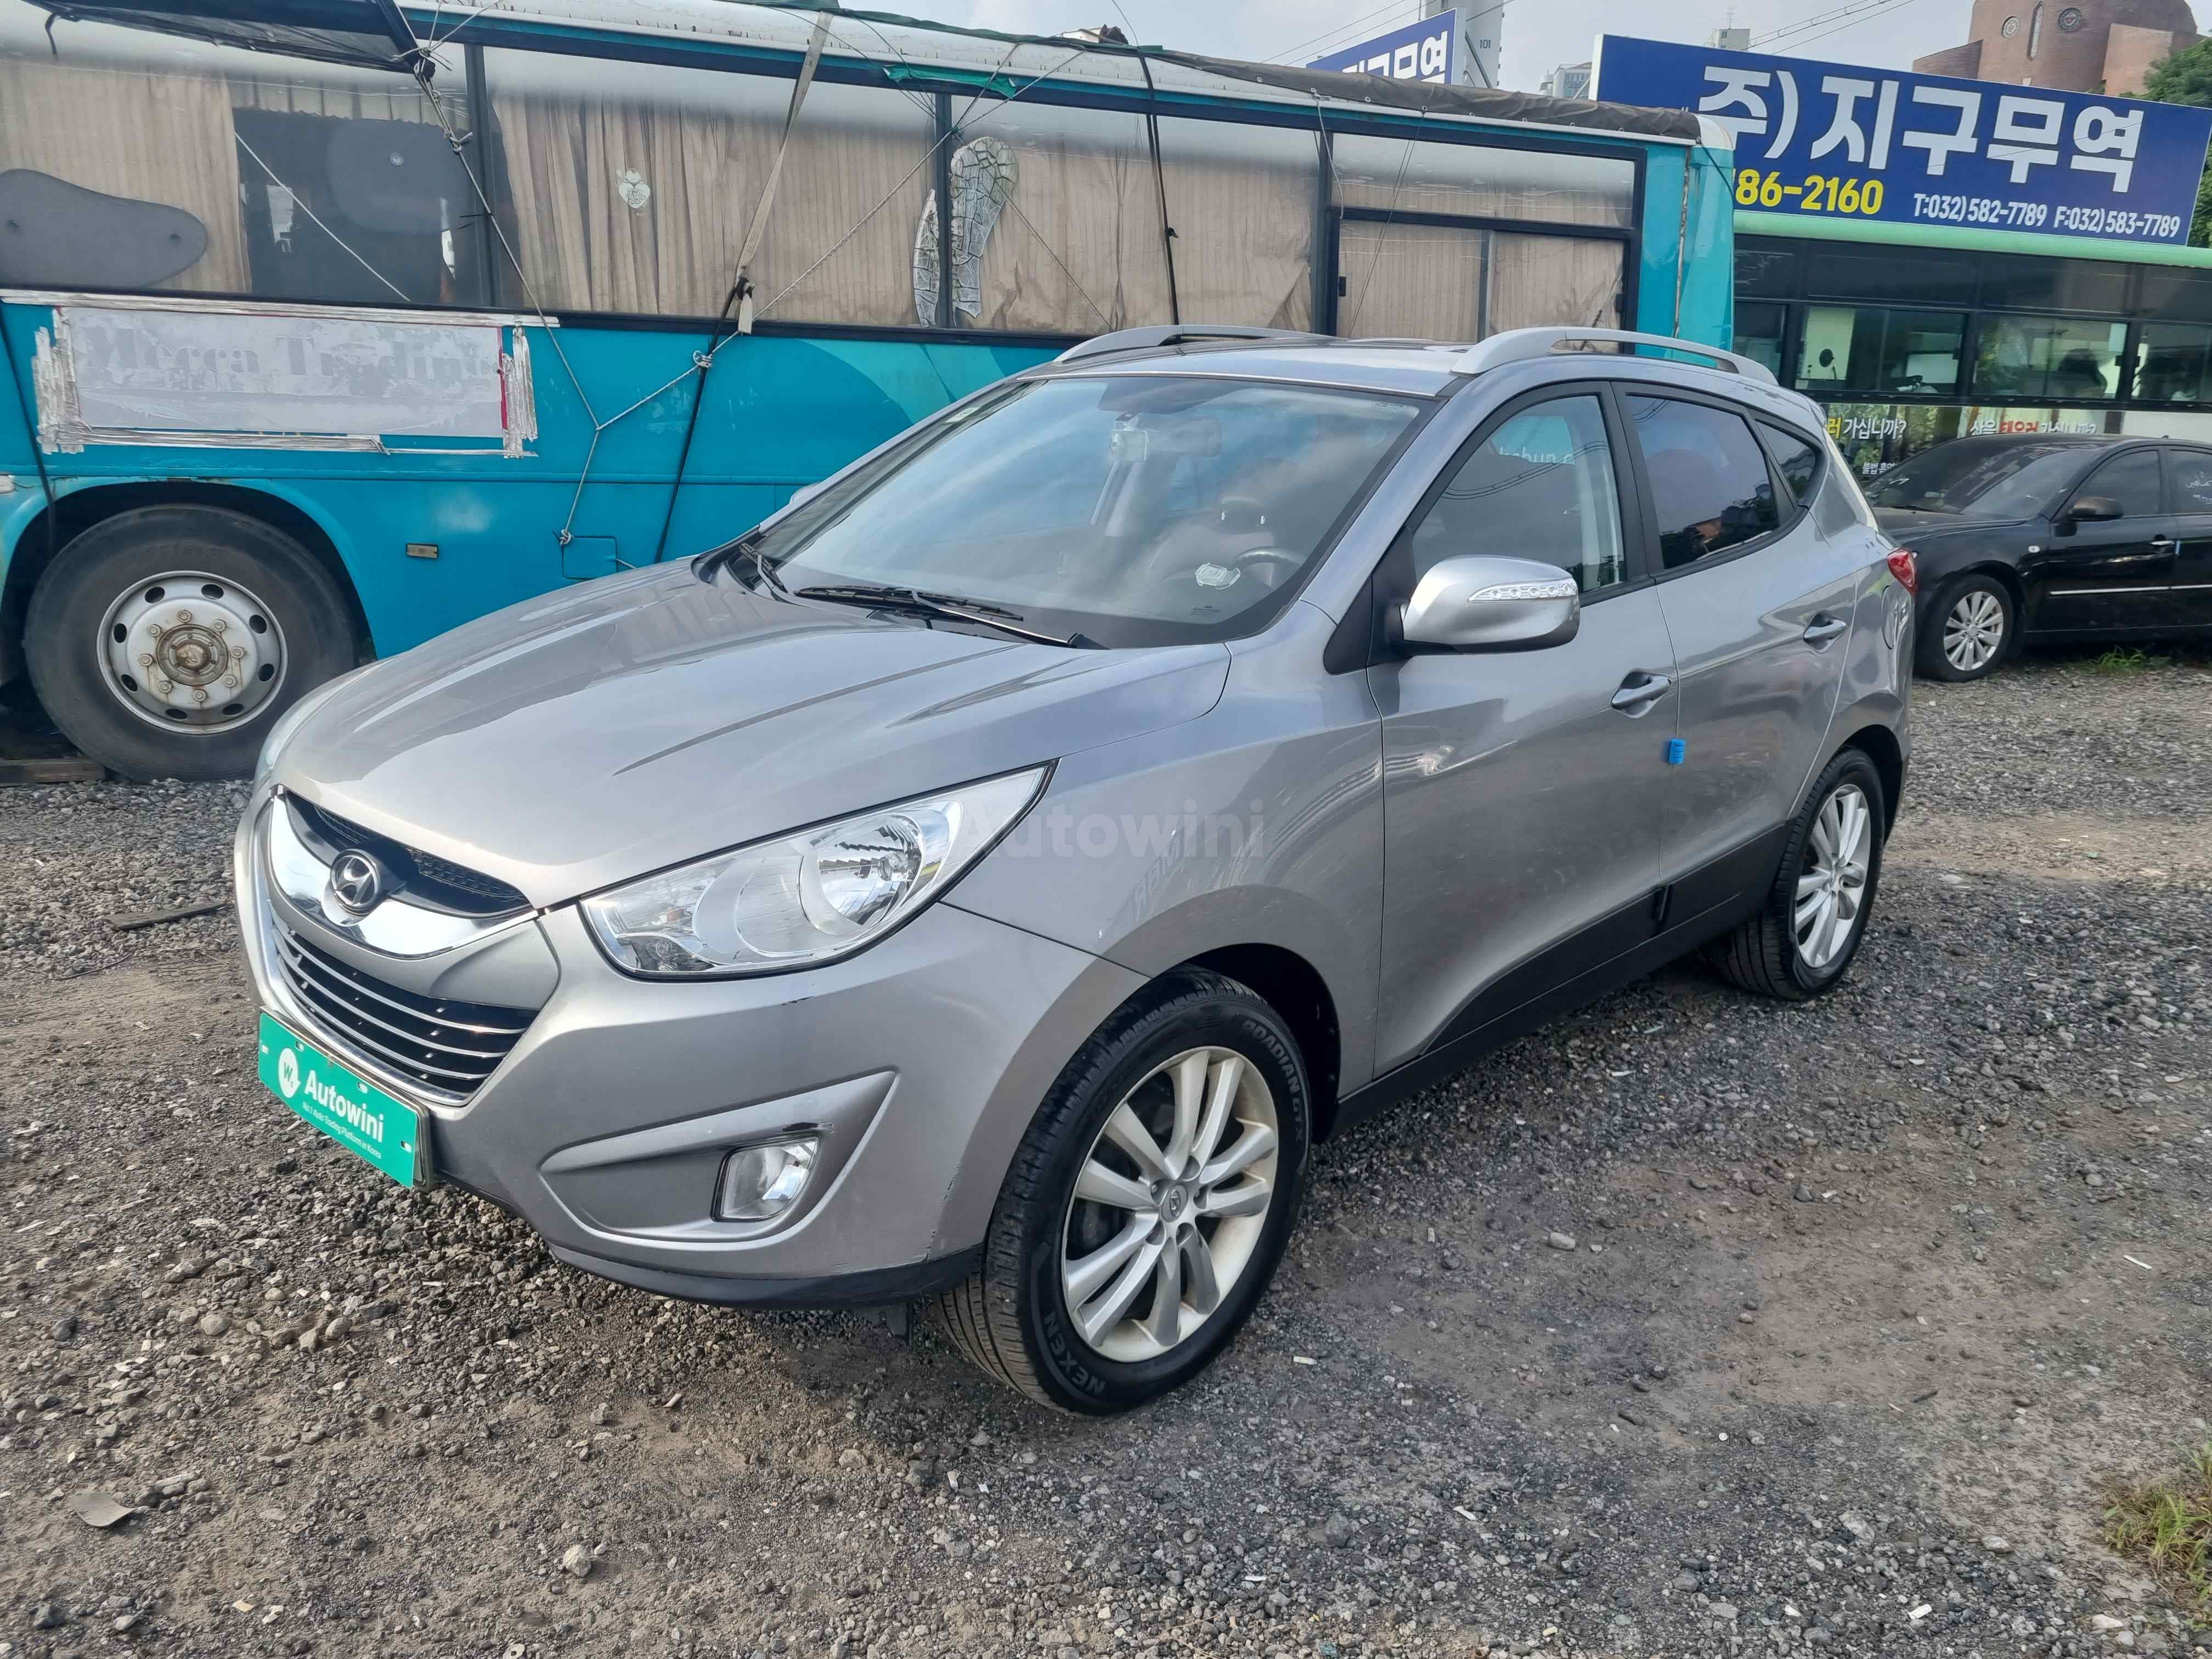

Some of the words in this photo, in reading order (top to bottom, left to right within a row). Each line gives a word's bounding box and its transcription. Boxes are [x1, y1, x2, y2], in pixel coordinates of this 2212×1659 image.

[1480, 39, 1491, 49] 101
[1733, 168, 1884, 215] 86-2160
[1843, 416, 1906, 439] 가십니까?
[304, 1070, 384, 1143] Autowini
[324, 1115, 341, 1135] Trading
[1043, 1311, 1107, 1395] NEXEN
